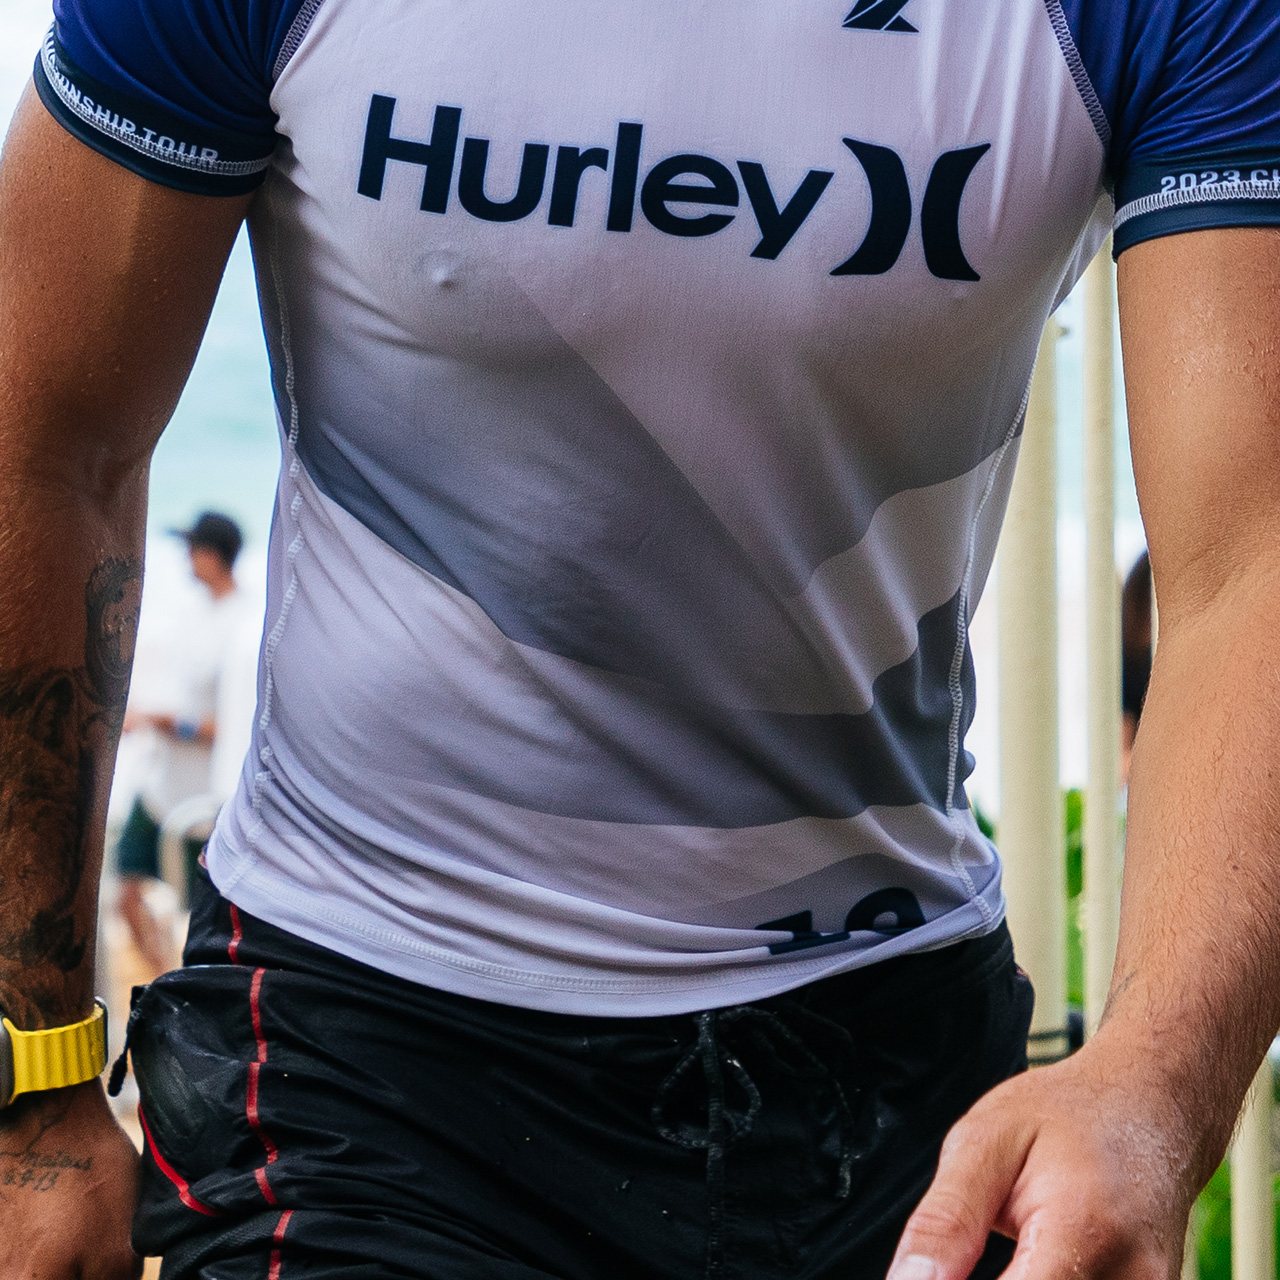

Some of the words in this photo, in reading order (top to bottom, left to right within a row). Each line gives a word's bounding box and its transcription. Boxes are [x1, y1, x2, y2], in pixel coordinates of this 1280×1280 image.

[142, 126, 219, 166] TOUR
[357, 93, 835, 260] Hurley
[1160, 169, 1241, 194] 2023
